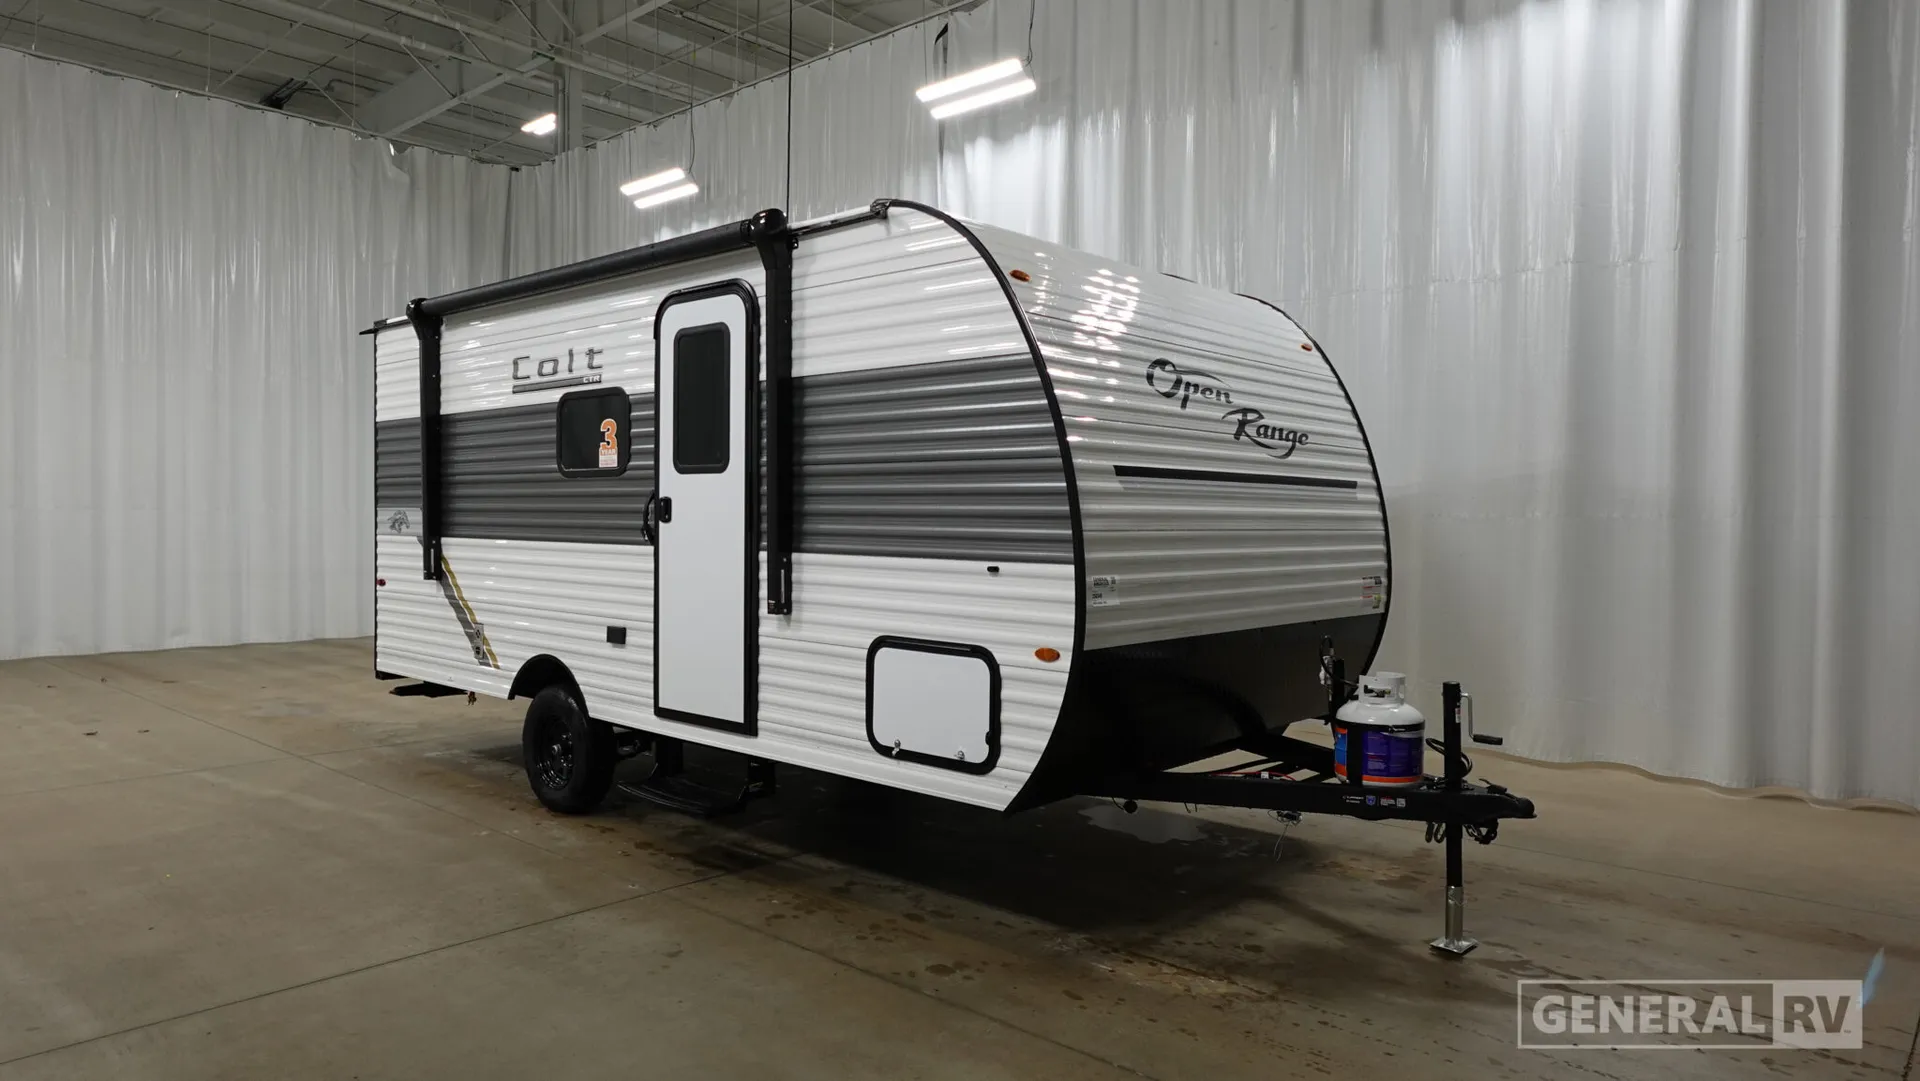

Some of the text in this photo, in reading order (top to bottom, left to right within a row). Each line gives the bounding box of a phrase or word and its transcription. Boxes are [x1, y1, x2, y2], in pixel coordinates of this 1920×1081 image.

[513, 348, 603, 380] Colt
[583, 375, 601, 384] CTR
[1146, 358, 1234, 410] Open
[600, 418, 618, 450] 3
[1221, 408, 1309, 459] Range
